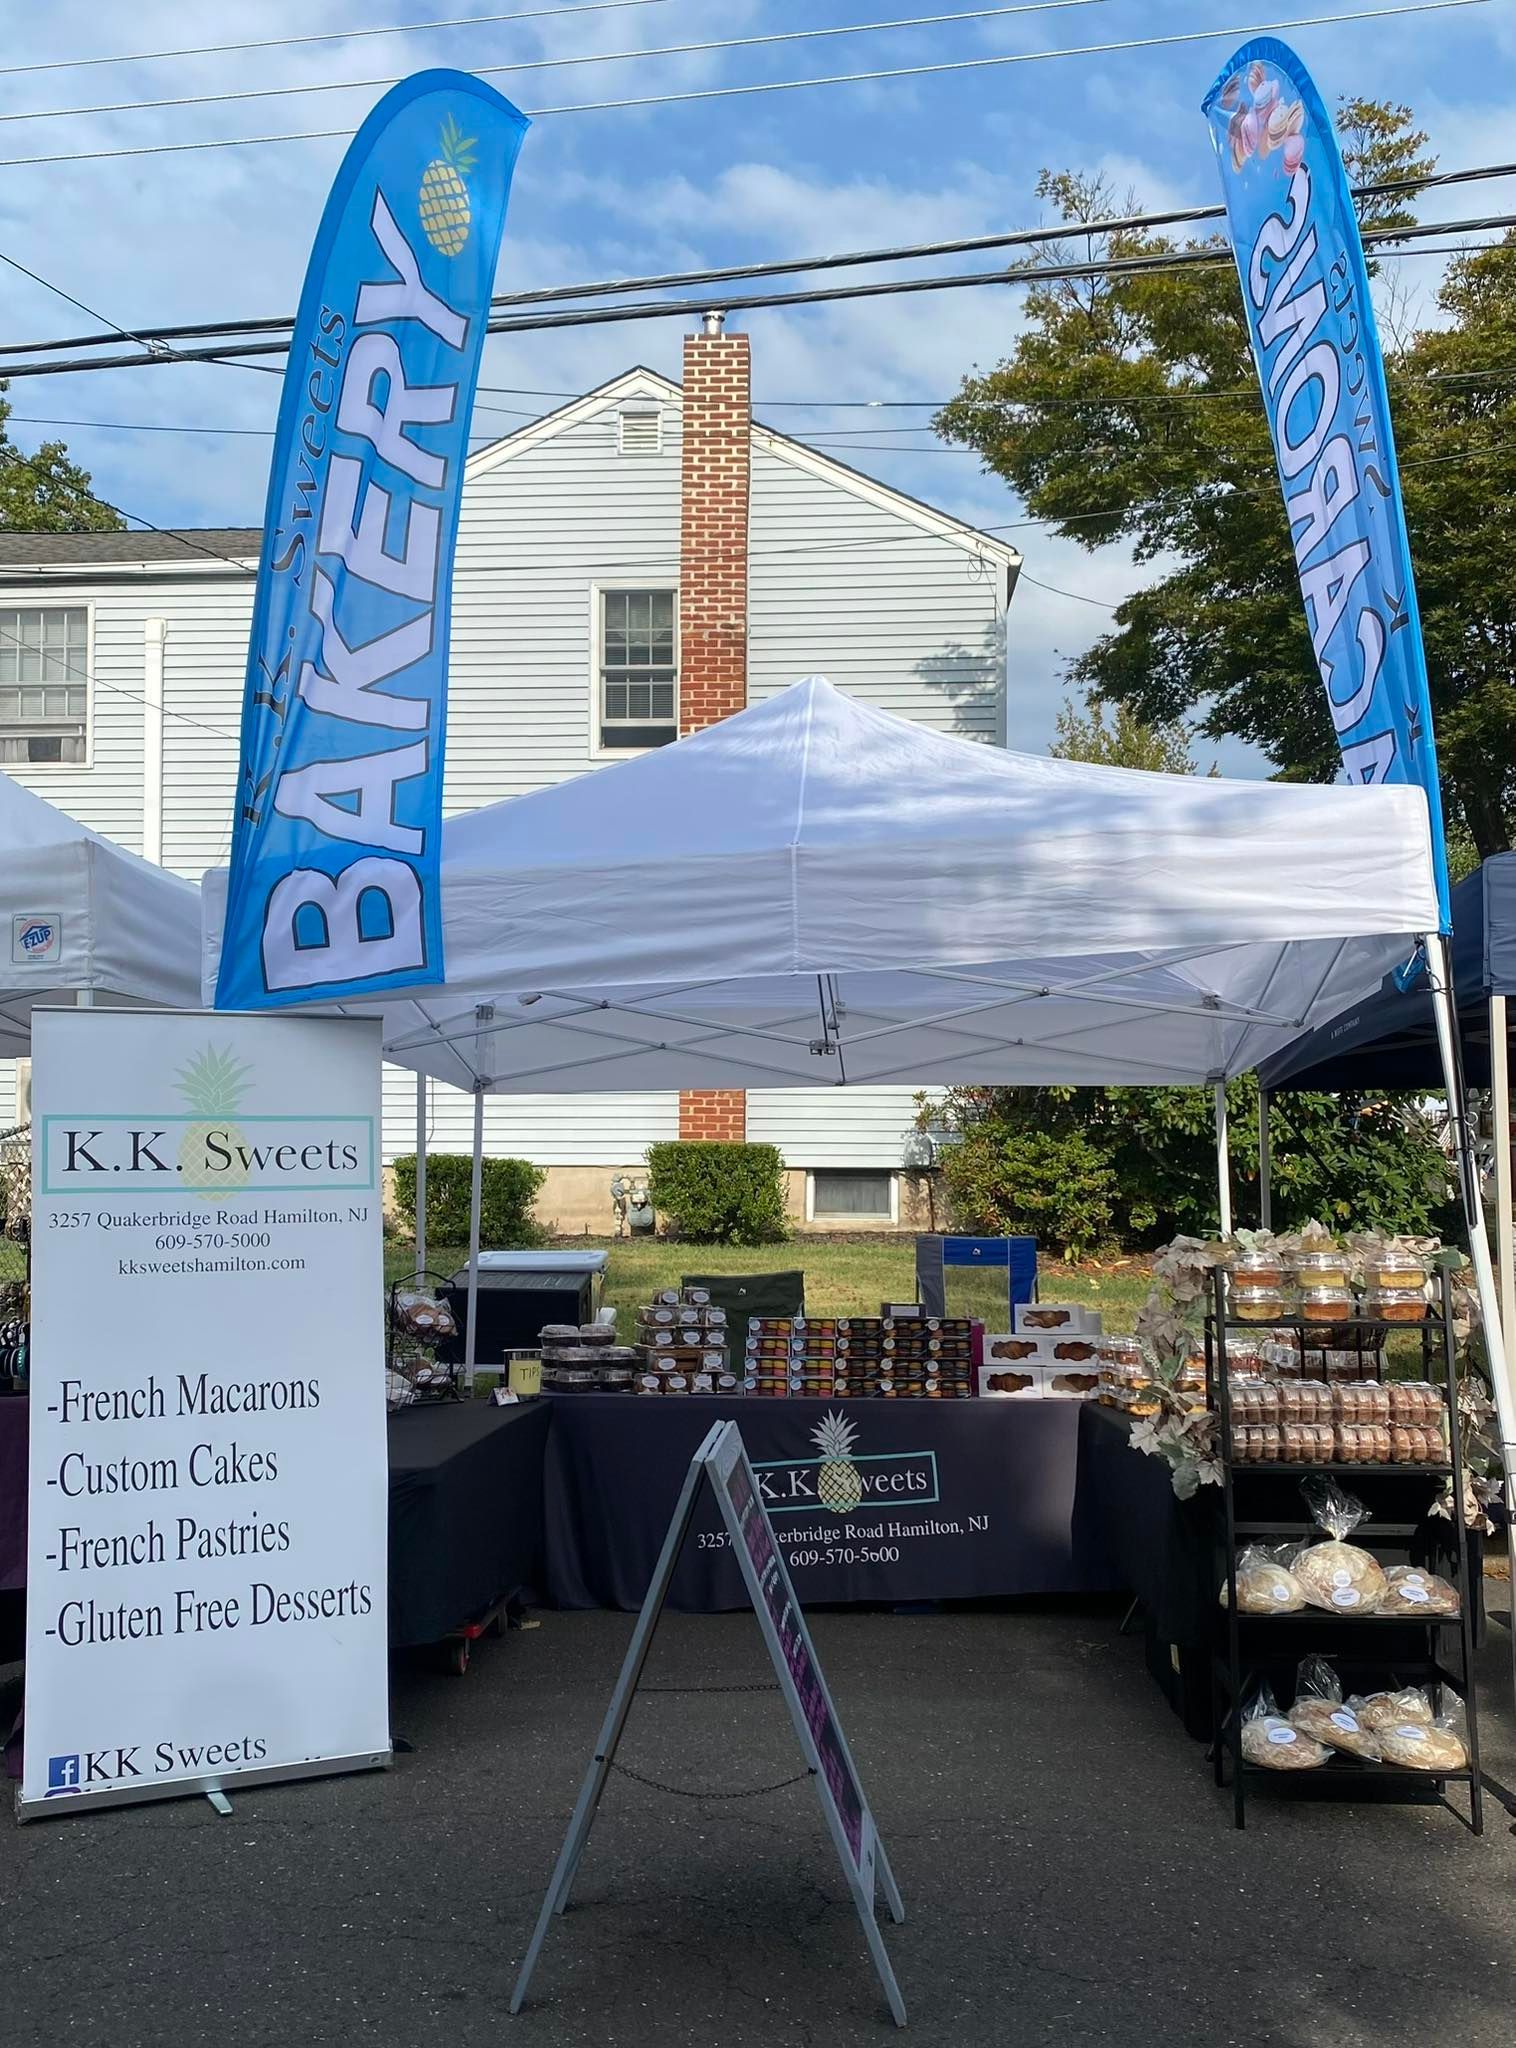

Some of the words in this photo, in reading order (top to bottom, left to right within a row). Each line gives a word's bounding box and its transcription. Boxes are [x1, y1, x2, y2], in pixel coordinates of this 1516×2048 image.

[271, 304, 346, 588] Sweets
[261, 185, 469, 994] BAKERY
[62, 1131, 183, 1172] K.K.
[205, 1130, 358, 1172] Sweets
[49, 1212, 91, 1229] 3257
[97, 1210, 211, 1231] Quakerbridge
[216, 1209, 259, 1226] Road
[263, 1207, 343, 1226] Hamilton,
[348, 1206, 369, 1223] NJ
[154, 1231, 271, 1251] 609-570-5000
[118, 1254, 306, 1276] kksweetshamilton.com
[46, 1375, 166, 1424] -French
[175, 1373, 320, 1417] Macarons
[46, 1451, 178, 1497] -Custom
[188, 1441, 278, 1487] Cakes
[45, 1519, 165, 1572] -French
[175, 1510, 290, 1561] Pastries
[844, 1522, 884, 1540] Road
[888, 1519, 964, 1538] Hamilton,
[968, 1514, 989, 1533] NJ
[44, 1599, 163, 1647] -Gluten
[173, 1590, 240, 1634] Free
[249, 1579, 372, 1627] Desserts
[84, 1746, 144, 1783] KK
[153, 1734, 268, 1775] Sweets
